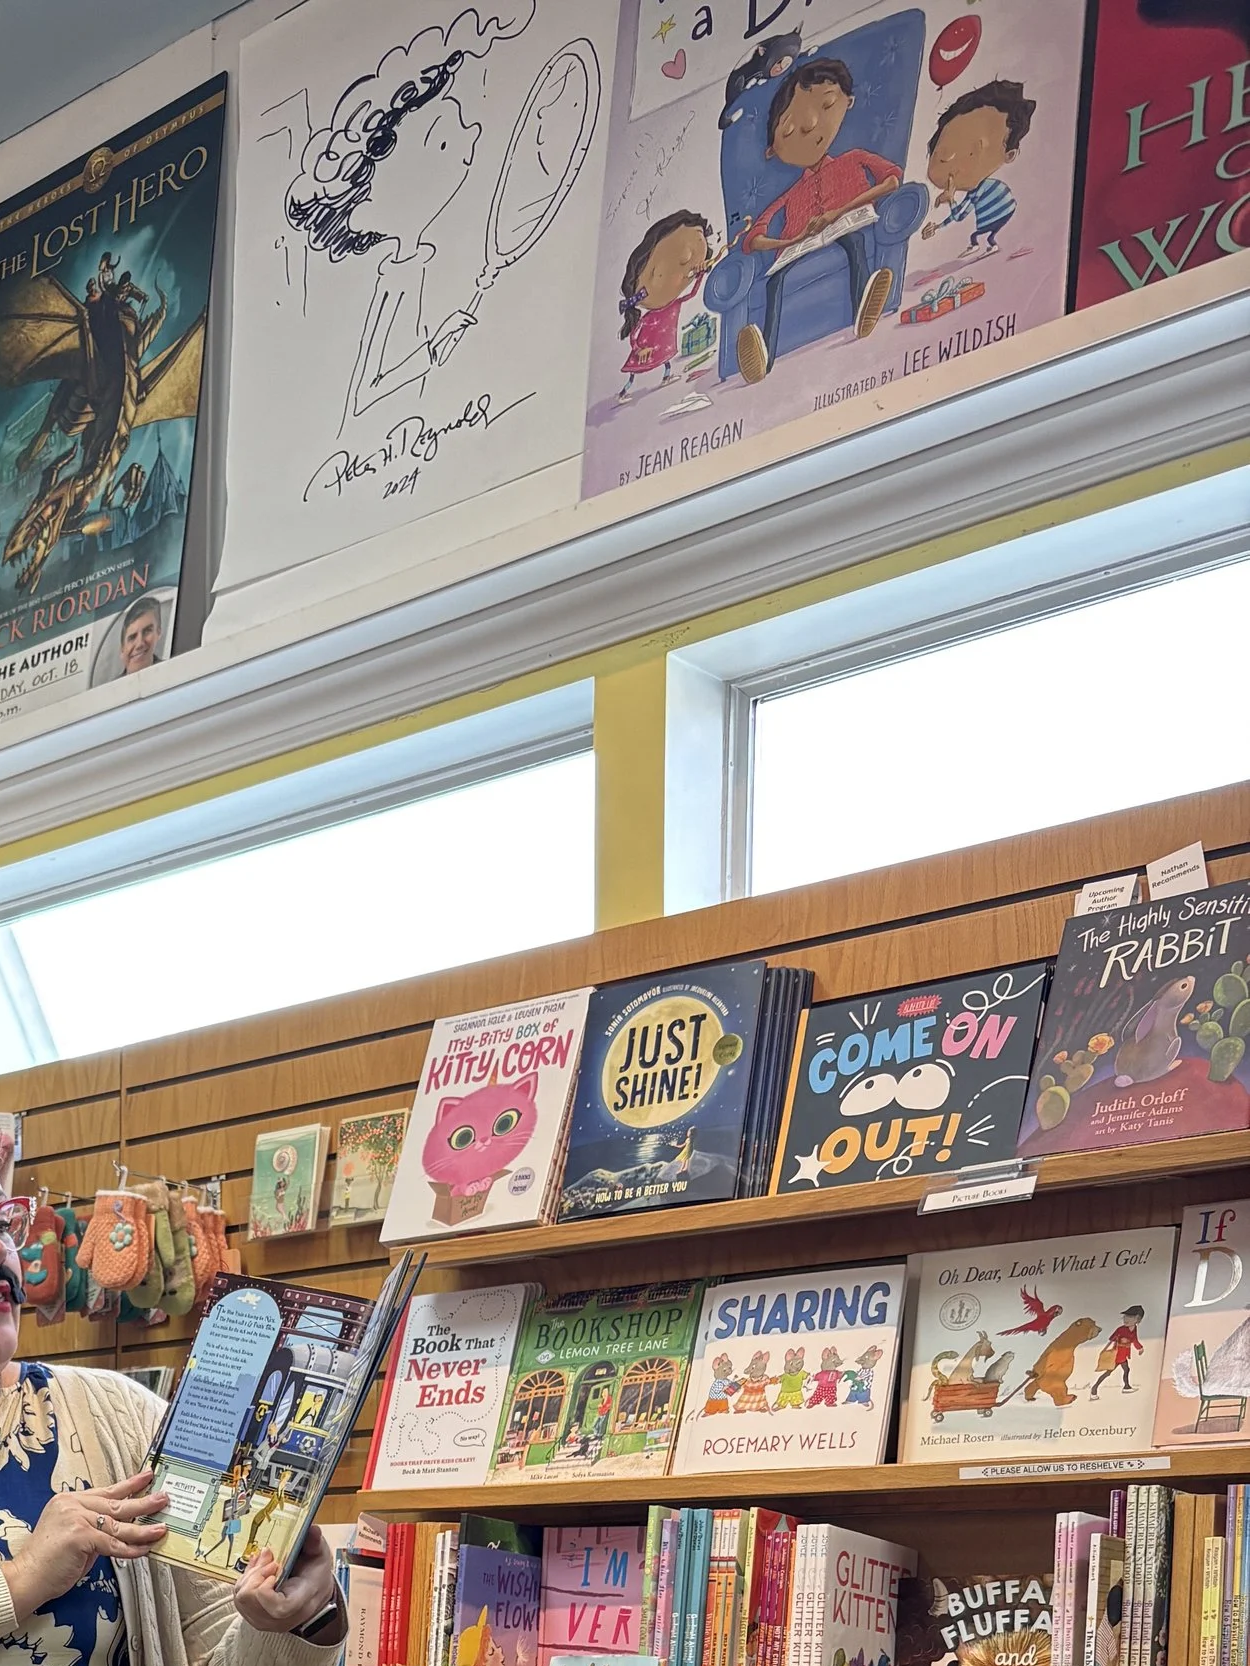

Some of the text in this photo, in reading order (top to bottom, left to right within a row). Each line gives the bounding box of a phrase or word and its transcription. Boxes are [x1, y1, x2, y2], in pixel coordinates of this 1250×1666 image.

[30, 201, 107, 280] LOST
[112, 146, 208, 234] HERO
[813, 313, 1017, 411] ILLUSTRATED BY LEE WILDISH
[619, 419, 743, 486] BY JEAN REAGAN
[31, 564, 150, 636] RIORDAN
[19, 633, 90, 670] AUTHOR!
[1152, 866, 1200, 888] Recommends
[1161, 861, 1189, 877] Nathan
[622, 987, 661, 1016] SOTOMAYOR
[619, 1013, 707, 1073] JUST
[808, 1011, 1018, 1094] COME ON
[614, 1063, 702, 1111] SHINE!
[819, 1113, 962, 1175] OUT!
[1196, 1209, 1237, 1244] If
[938, 1248, 1152, 1287] Oh Dear, Look What I Got!
[534, 1308, 683, 1351] BOOKSHOP
[714, 1282, 891, 1340] SHARING
[410, 1334, 495, 1355] Book That
[427, 1325, 451, 1336] The
[404, 1357, 487, 1382] Never
[416, 1381, 485, 1408] Ends
[703, 1431, 857, 1456] ROSEMARY WELLS
[990, 1461, 1125, 1476] PLEASE ALLOW US TO RESHELVE
[994, 1644, 1038, 1666] and
